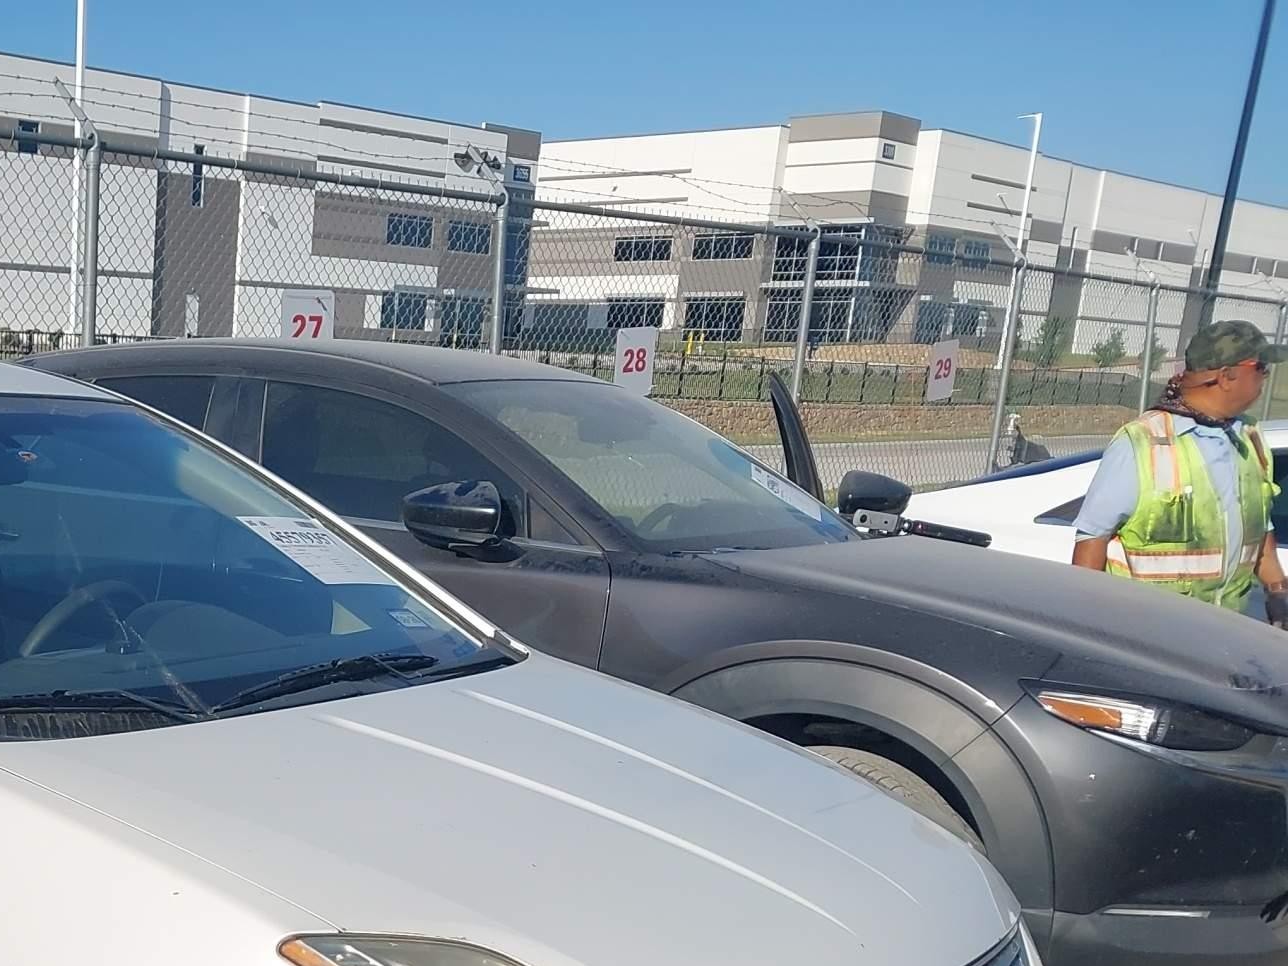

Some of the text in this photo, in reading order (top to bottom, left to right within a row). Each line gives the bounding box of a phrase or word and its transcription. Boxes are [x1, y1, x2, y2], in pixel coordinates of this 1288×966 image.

[291, 314, 324, 339] 27
[622, 347, 648, 374] 28
[934, 357, 952, 381] 29
